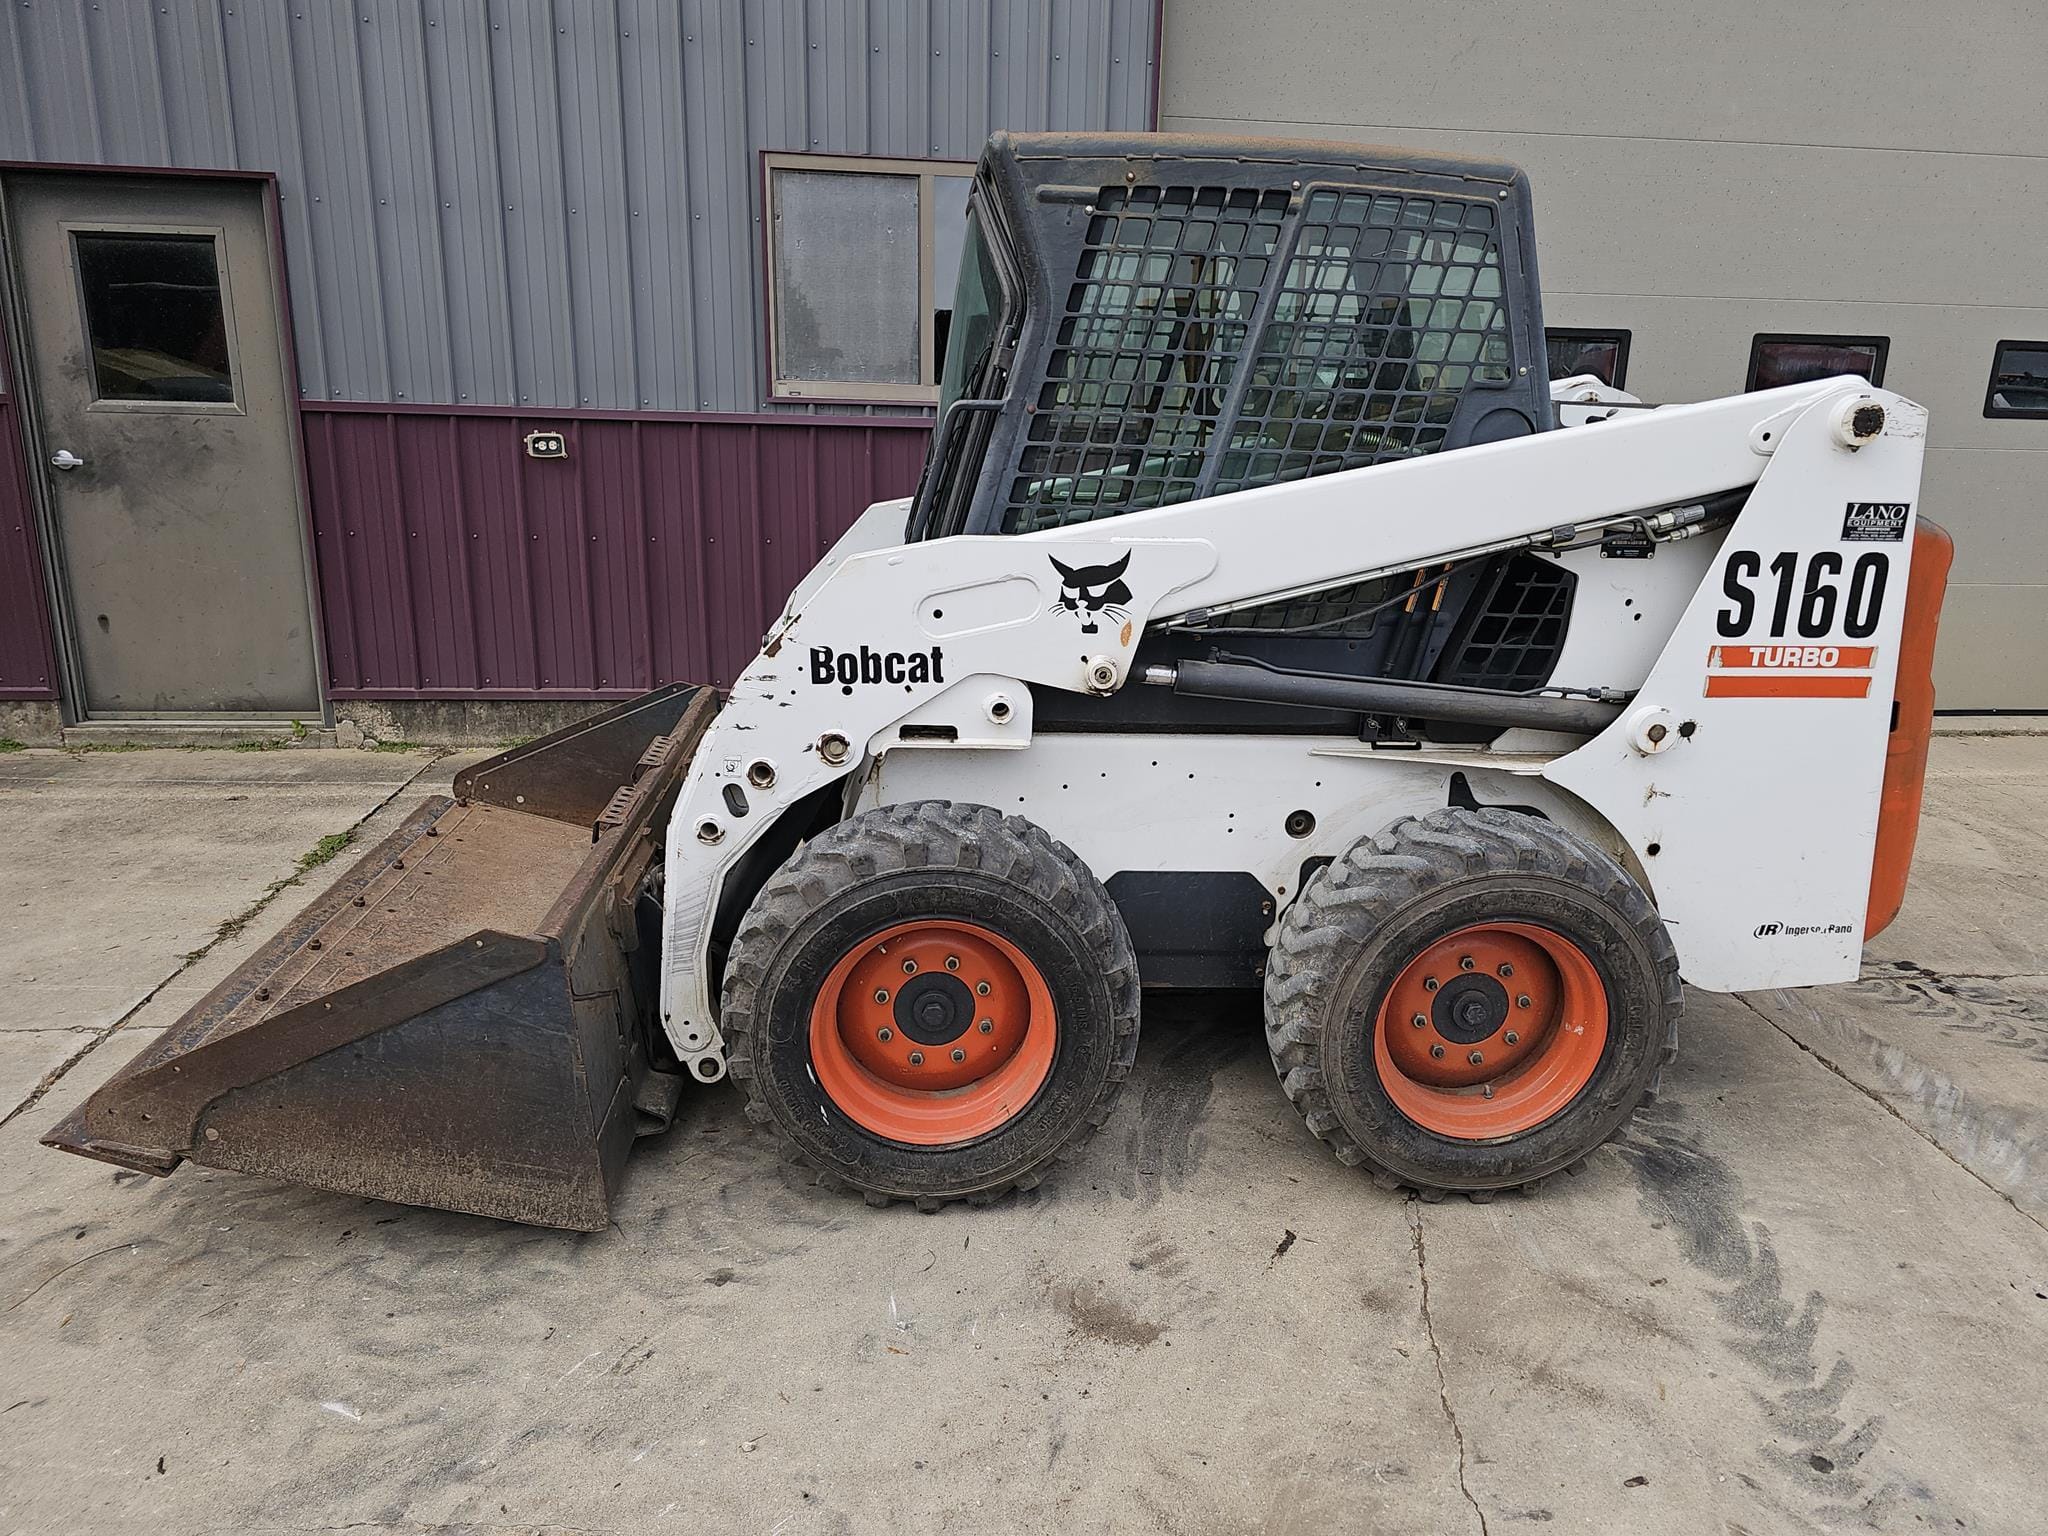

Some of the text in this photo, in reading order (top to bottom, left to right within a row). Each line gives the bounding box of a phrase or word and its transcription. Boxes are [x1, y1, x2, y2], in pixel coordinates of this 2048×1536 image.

[1848, 503, 1906, 520] LANO
[1846, 519, 1904, 527] EQUIPMENT
[1716, 550, 1890, 639] S160
[810, 645, 945, 685] Bobcat
[1749, 646, 1840, 668] TURBO
